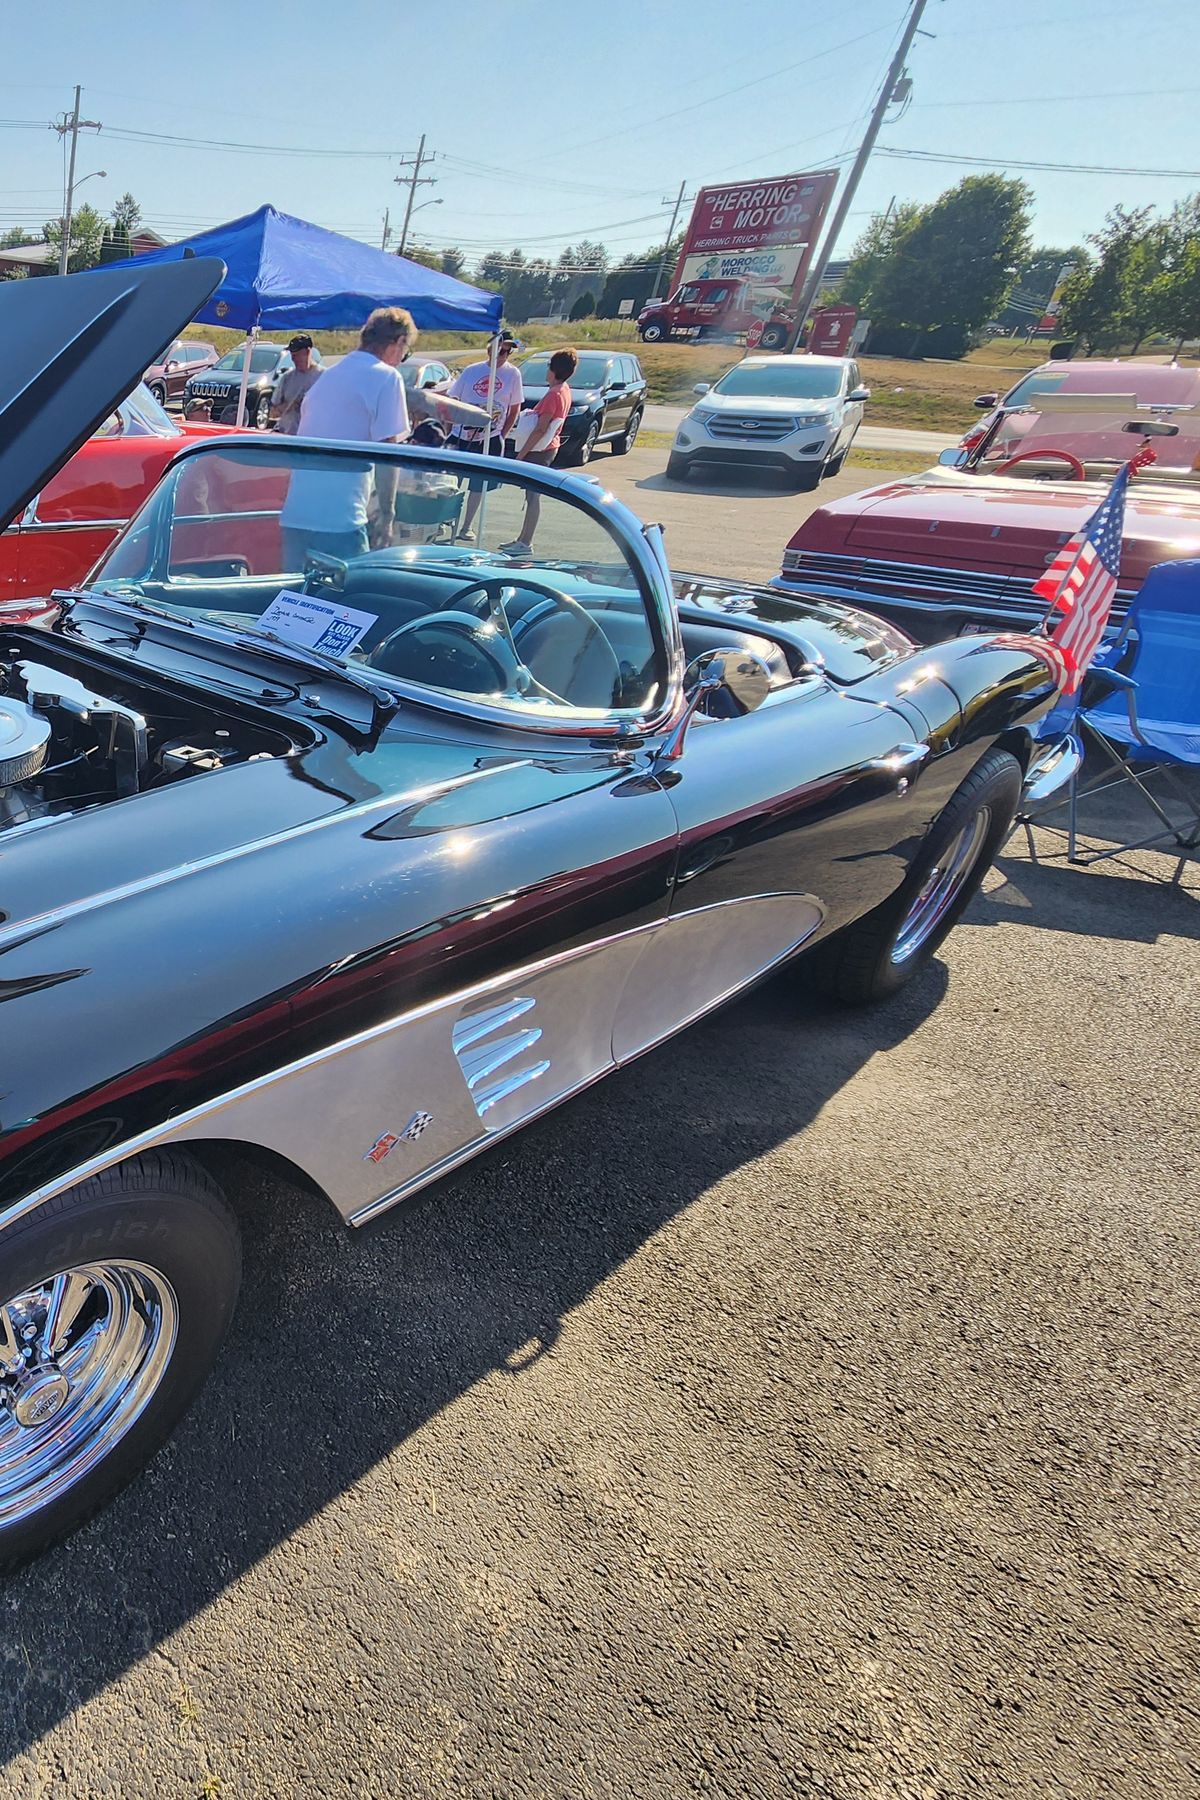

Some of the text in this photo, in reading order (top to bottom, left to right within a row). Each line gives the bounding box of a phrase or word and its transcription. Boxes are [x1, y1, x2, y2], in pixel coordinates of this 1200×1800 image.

[712, 184, 798, 212] HERRING
[733, 204, 802, 229] MOTOR
[694, 230, 788, 248] HERRING TRUCK PARTS
[721, 255, 776, 268] MOROCCO
[721, 264, 769, 277] WELDING
[749, 328, 761, 340] STOP
[281, 596, 299, 605] VEHICLE
[299, 601, 335, 615] IDENTIFICATION
[328, 621, 359, 638] LOOK
[313, 642, 342, 657] Touch
[322, 636, 348, 649] Don't
